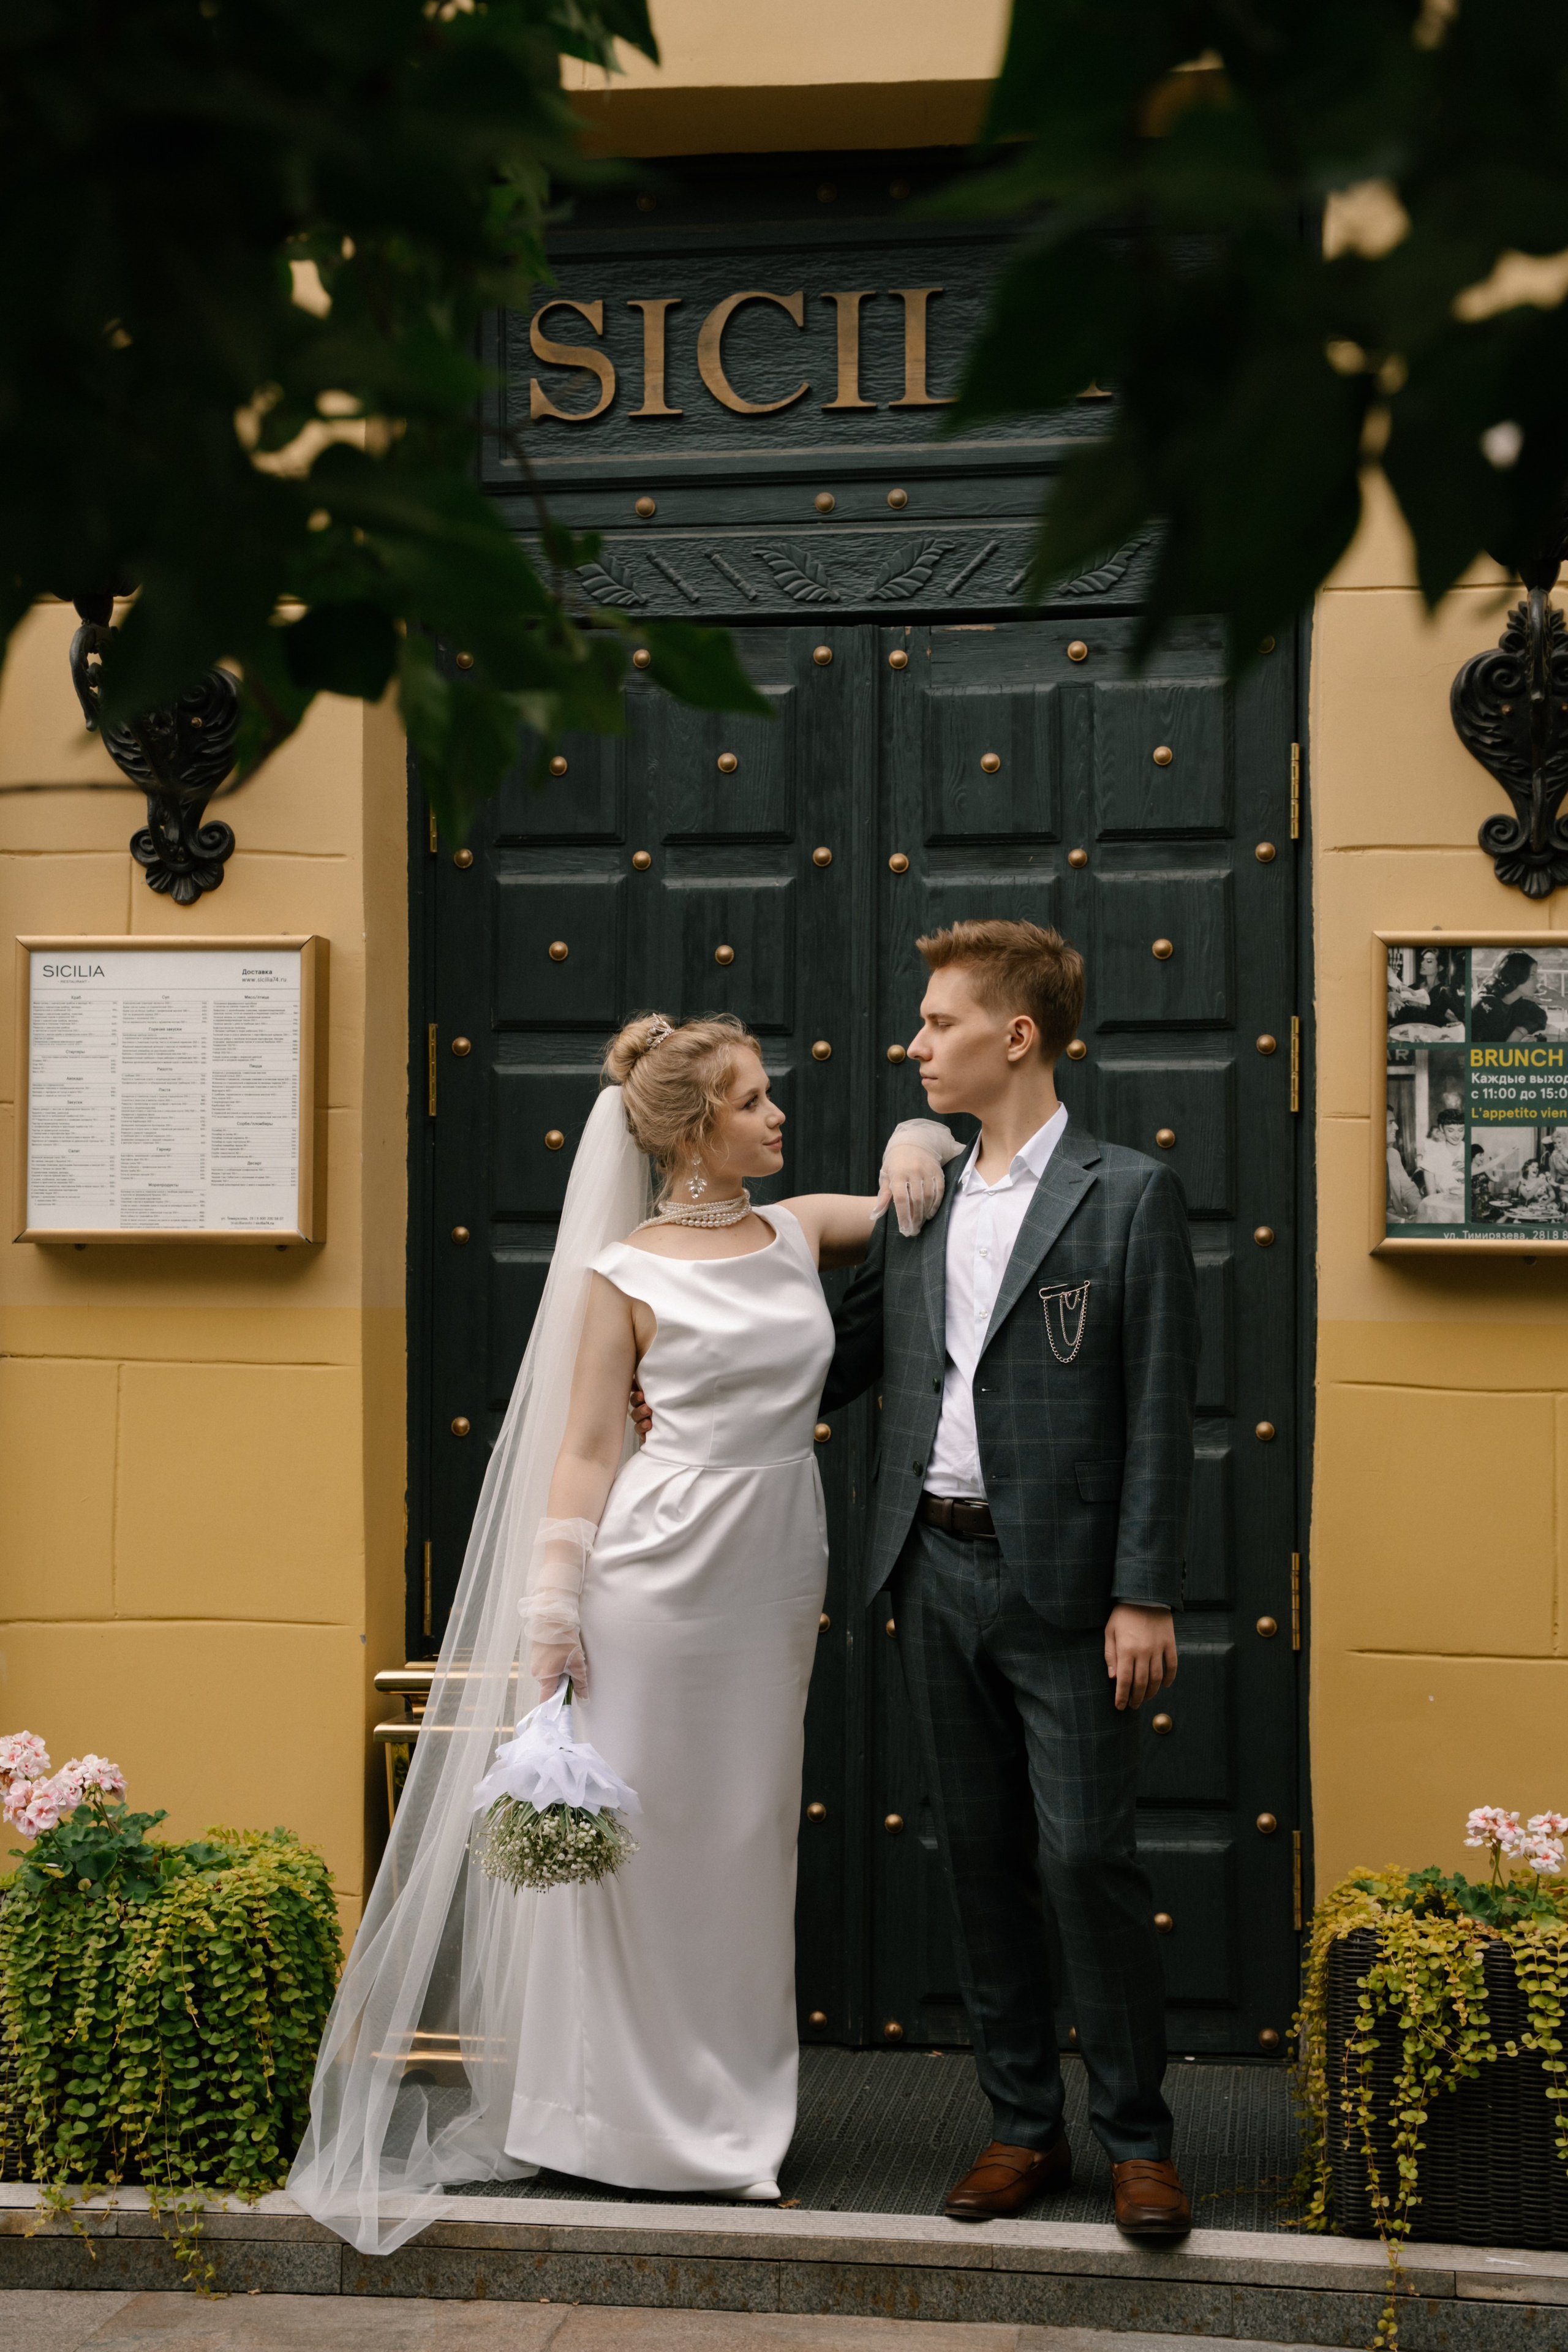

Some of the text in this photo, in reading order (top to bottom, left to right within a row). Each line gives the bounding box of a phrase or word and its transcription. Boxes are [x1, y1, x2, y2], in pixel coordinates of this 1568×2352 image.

[43, 965, 105, 978] SICILIA
[1470, 1049, 1563, 1067] BRUNCH
[1471, 1072, 1526, 1085] Каждые
[1471, 1090, 1479, 1099] с
[1482, 1088, 1517, 1099] 11:00
[1520, 1090, 1537, 1101] до
[1471, 1107, 1537, 1121] L'appetito
[1462, 1231, 1529, 1240] Тимирязева,
